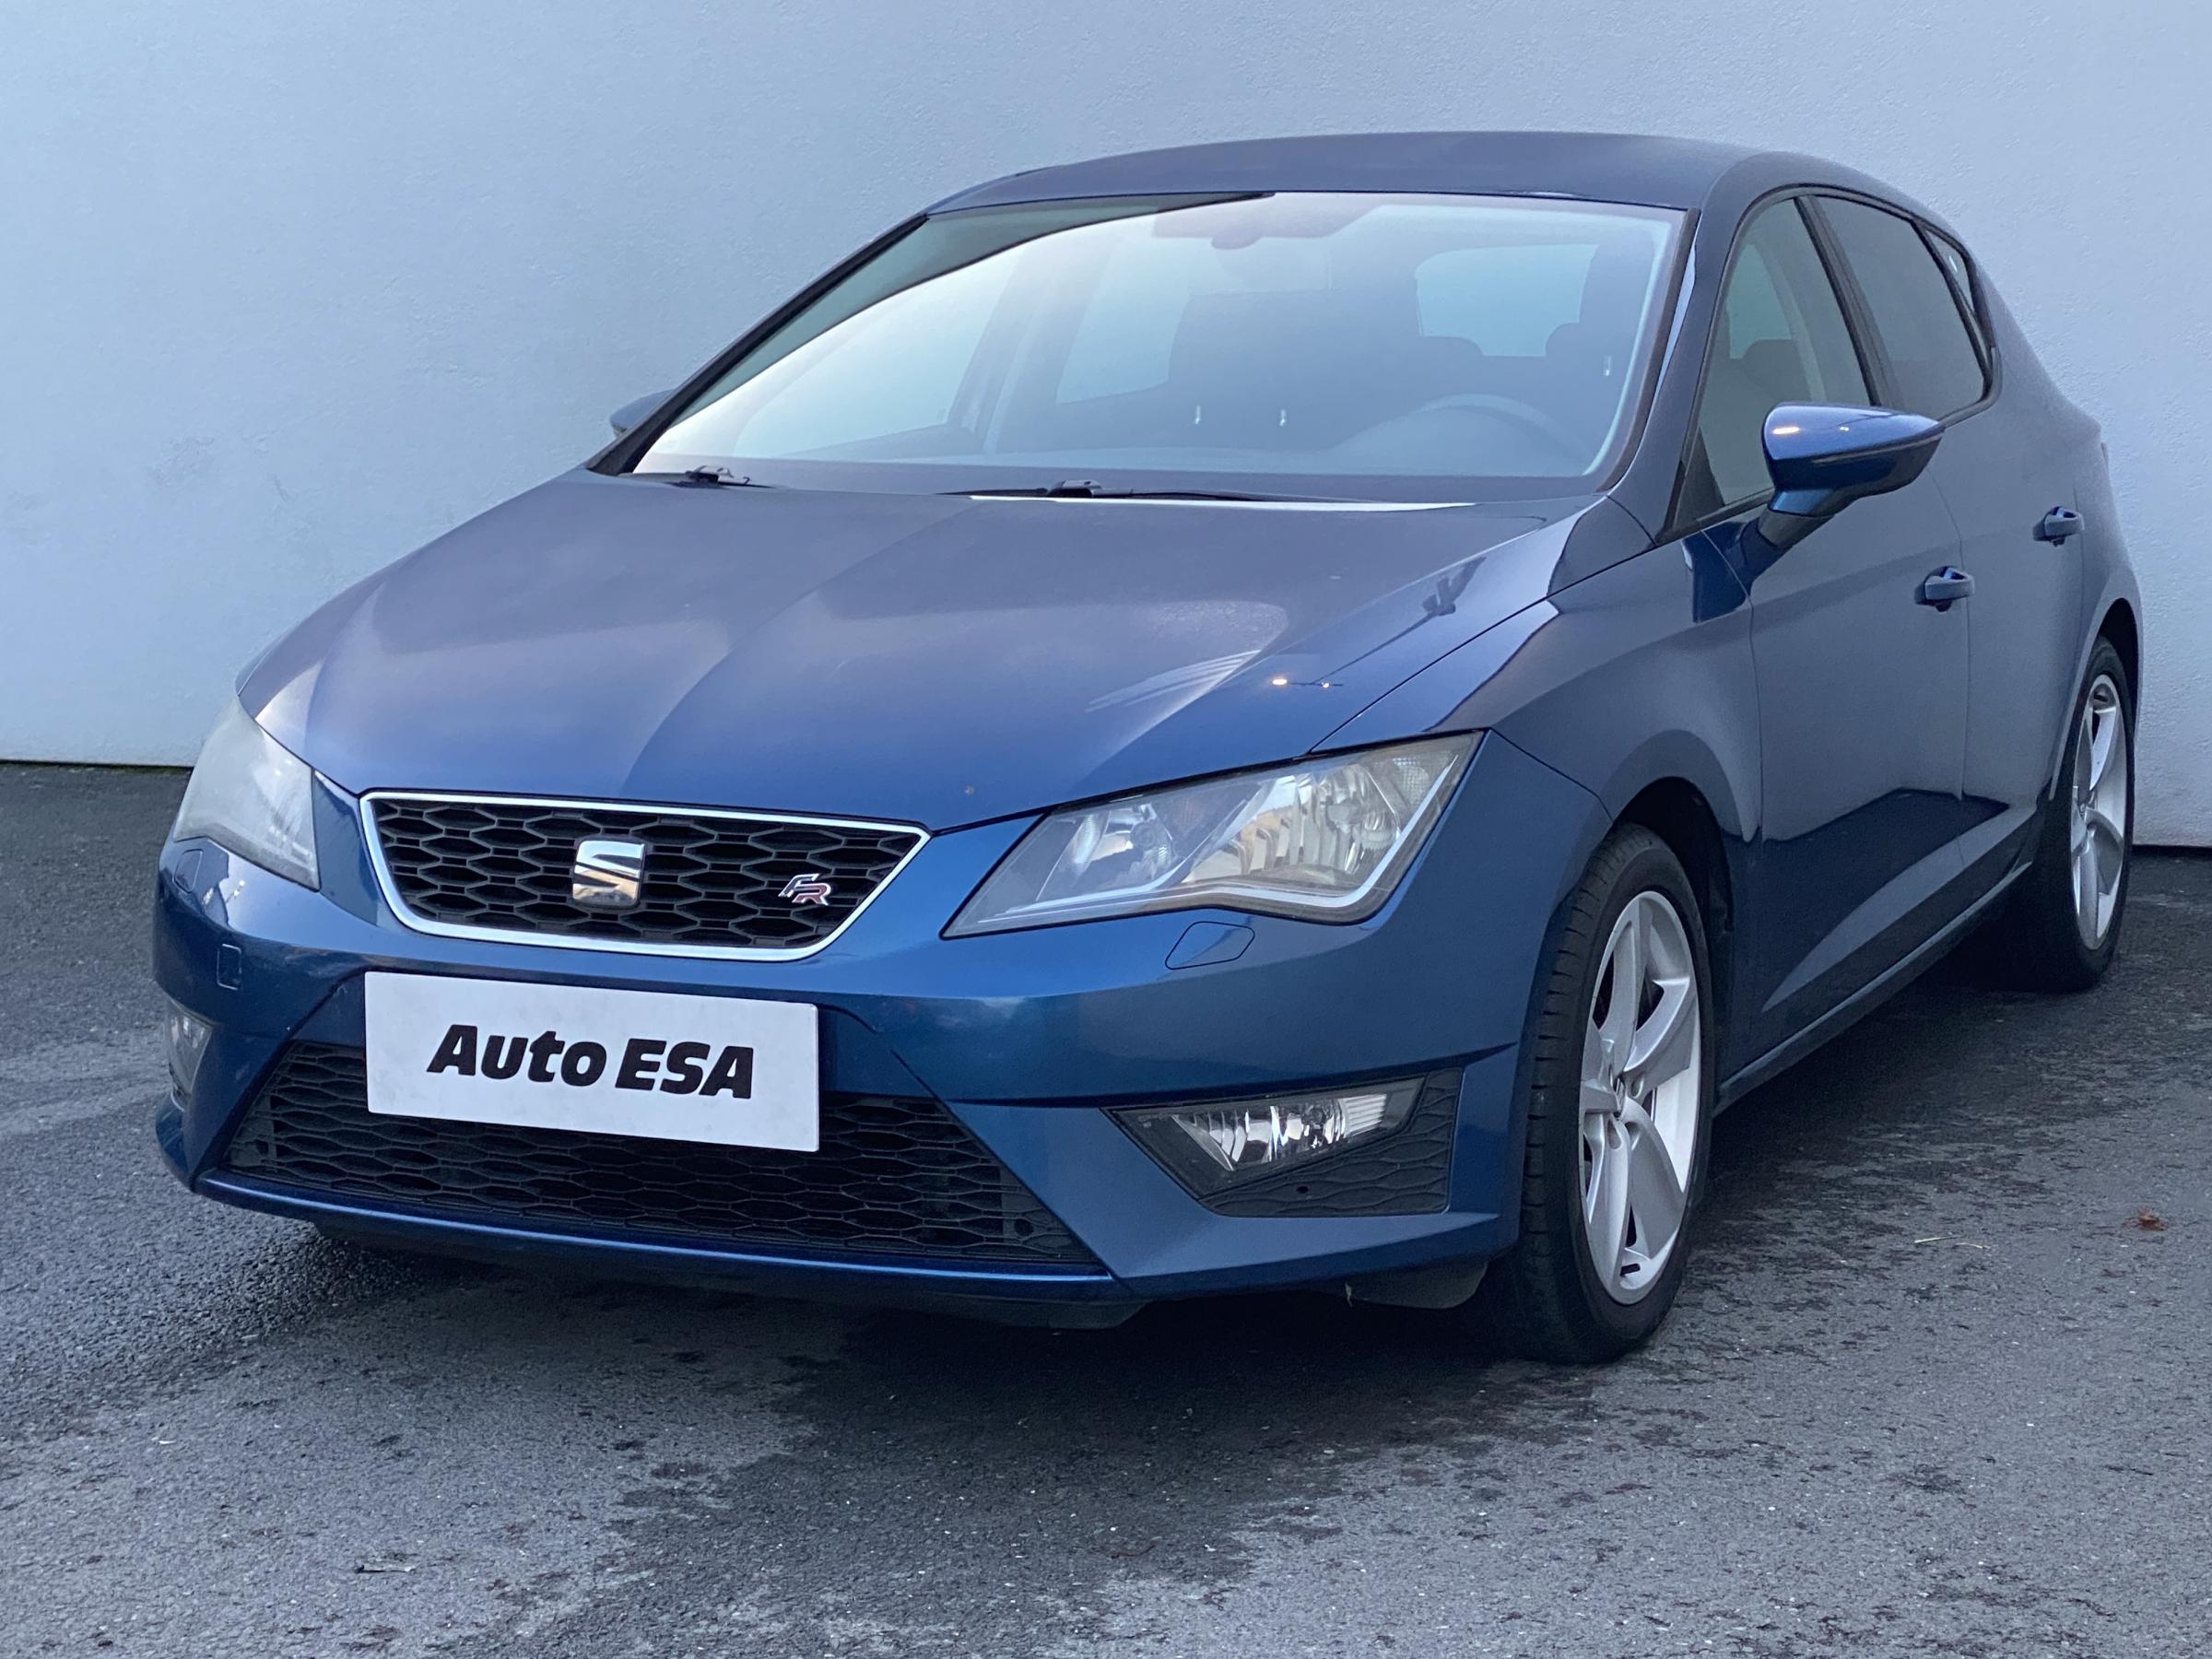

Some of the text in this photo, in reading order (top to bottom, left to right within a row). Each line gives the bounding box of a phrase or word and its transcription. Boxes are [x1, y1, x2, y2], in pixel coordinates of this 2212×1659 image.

[778, 873, 831, 906] FR
[426, 1024, 754, 1100] Auto ESA
